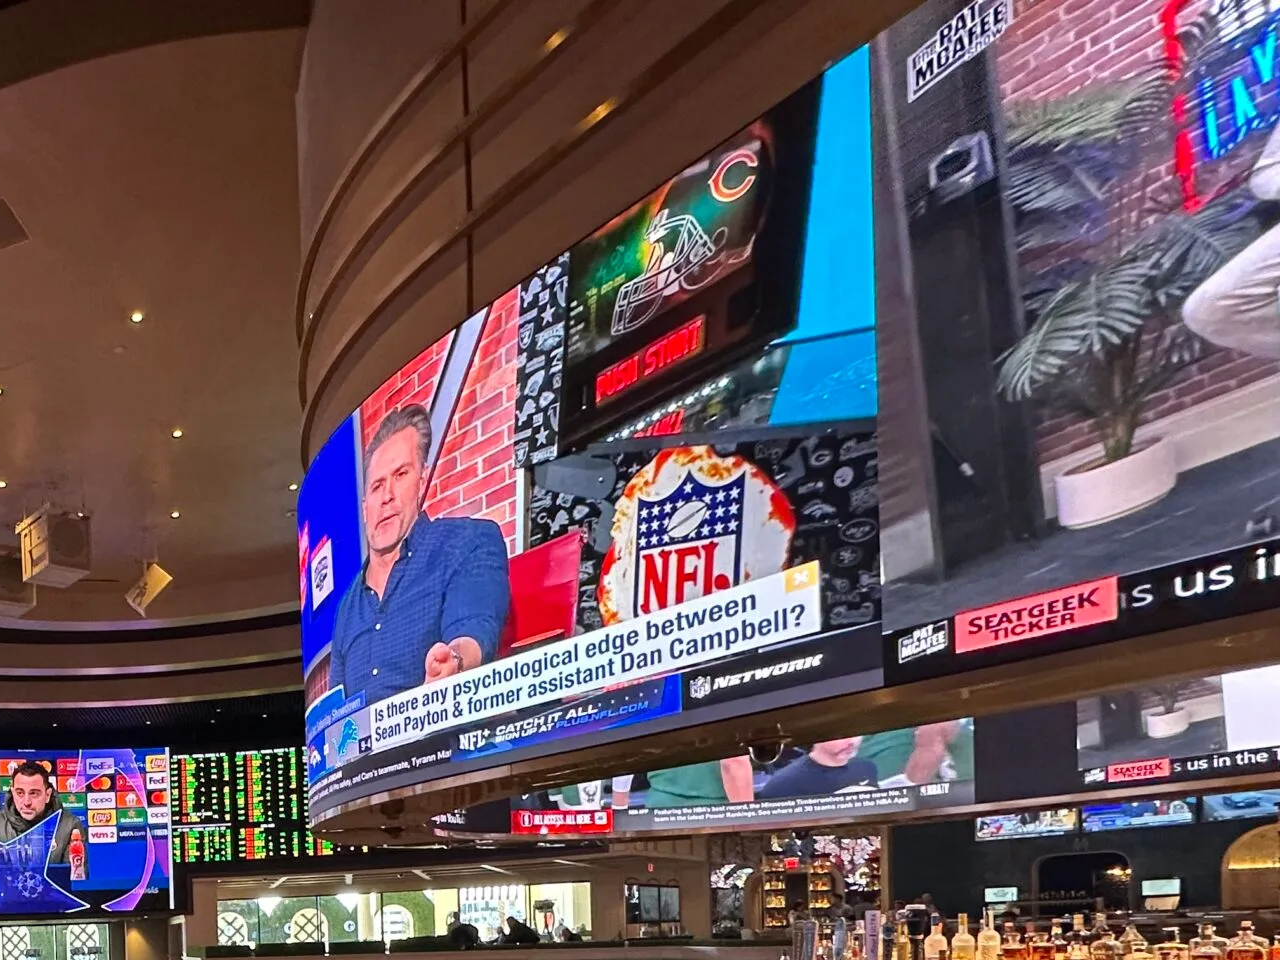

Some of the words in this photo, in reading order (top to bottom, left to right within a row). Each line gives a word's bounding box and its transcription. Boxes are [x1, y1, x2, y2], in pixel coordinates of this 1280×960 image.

[940, 3, 977, 47] PAT
[916, 2, 1004, 87] MCAFEE
[596, 355, 639, 402] PUSH
[640, 540, 730, 615] NFL
[1174, 565, 1234, 597] us
[968, 588, 1099, 635] SEATGEEK
[991, 613, 1075, 640] TICKER
[902, 632, 946, 658] MCAFEE
[913, 625, 934, 640] PAT
[374, 707, 384, 723] Is
[387, 697, 418, 716] there
[422, 687, 449, 706] any
[452, 643, 579, 699] psychological
[585, 629, 639, 658] edge
[646, 593, 756, 641] between
[375, 721, 401, 742] Sean
[404, 708, 448, 735] Payton
[453, 701, 464, 718] &
[467, 687, 523, 714] former
[527, 658, 616, 699] assistant
[621, 649, 662, 674] Dan
[669, 603, 806, 660] Campbell?
[712, 653, 824, 690] NETWORK
[495, 717, 545, 736] CATCH
[547, 712, 564, 724] IT
[566, 704, 599, 720] ALL
[521, 727, 537, 738] UP
[538, 723, 555, 735] AT
[556, 701, 649, 729] PLUS.NFL.COM
[89, 761, 113, 770] FedEx
[1113, 762, 1163, 776] SEATGEEK
[1122, 770, 1154, 779] TICKER
[1187, 758, 1208, 771] us
[1213, 754, 1230, 768] in
[1235, 751, 1269, 765] the
[814, 803, 835, 811] teams
[837, 802, 853, 810] rank
[863, 799, 875, 807] the
[876, 797, 893, 806] NBA
[894, 795, 909, 805] App
[872, 791, 888, 799] new
[889, 789, 901, 798] No.
